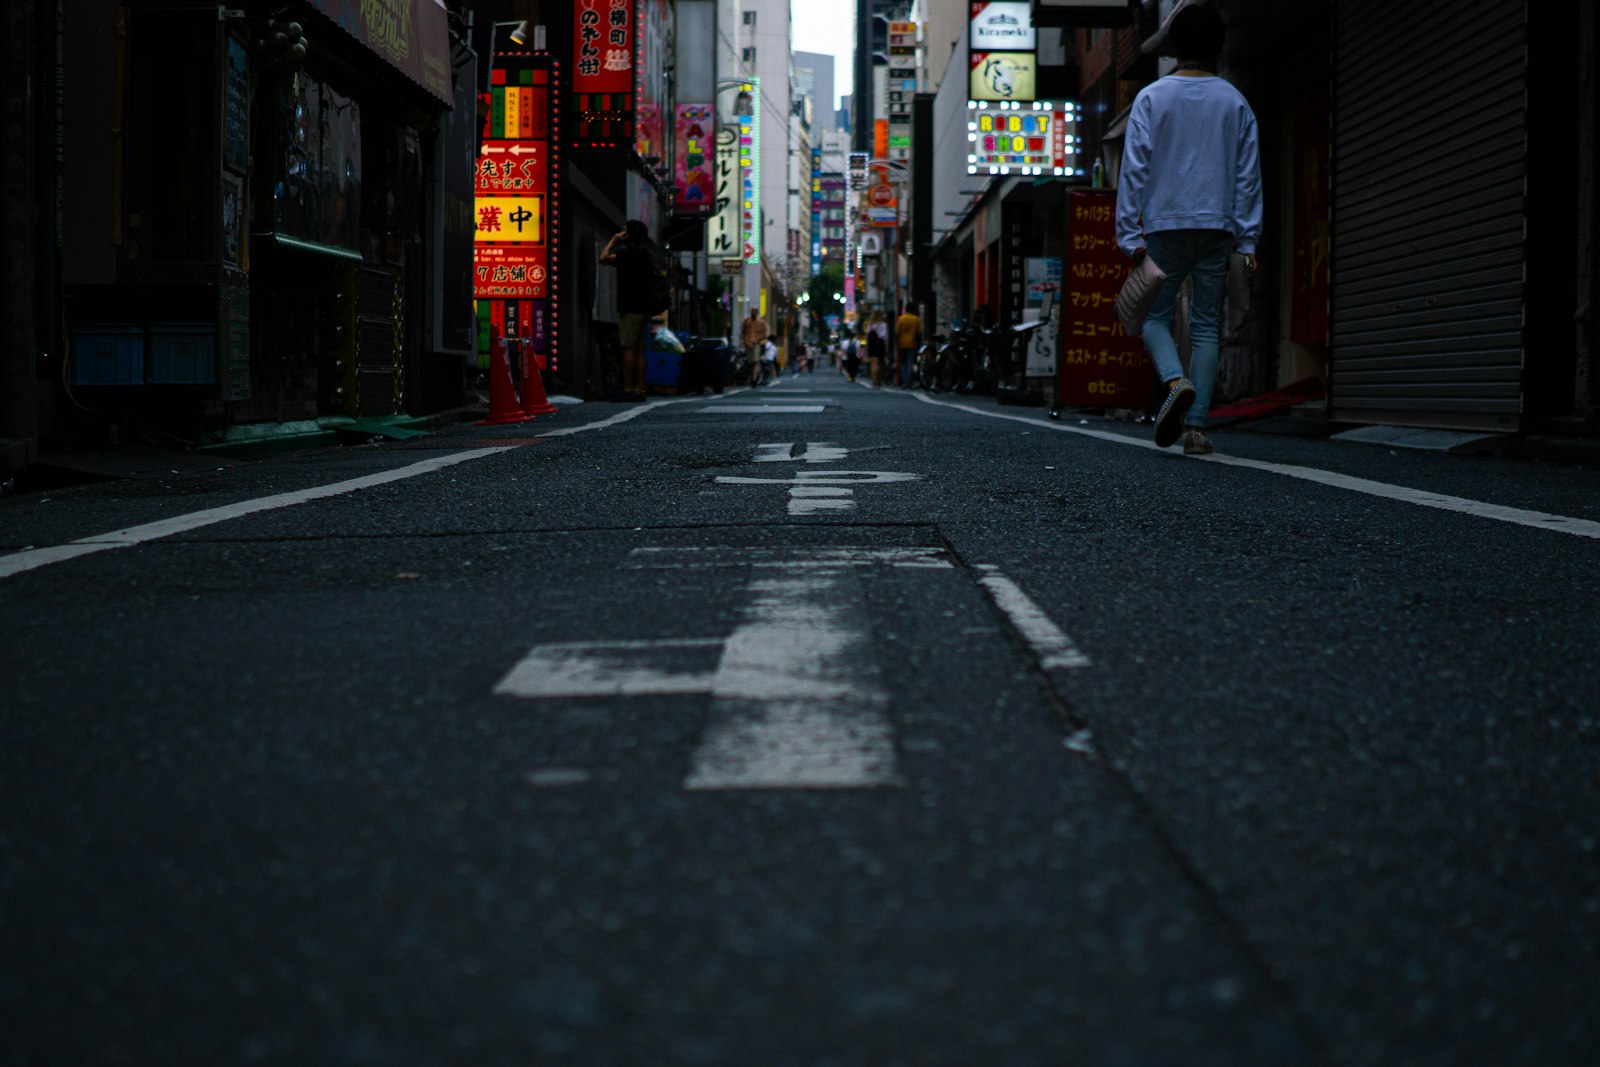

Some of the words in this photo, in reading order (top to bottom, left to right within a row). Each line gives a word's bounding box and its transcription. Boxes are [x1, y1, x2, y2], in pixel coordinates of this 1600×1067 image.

[978, 27, 1028, 37] Kirameki
[979, 115, 1048, 132] ROBOT
[983, 134, 1045, 153] SHOW
[686, 123, 705, 201] ALPHA
[474, 205, 534, 233] 業中
[1010, 254, 1023, 363] KAMIKZE
